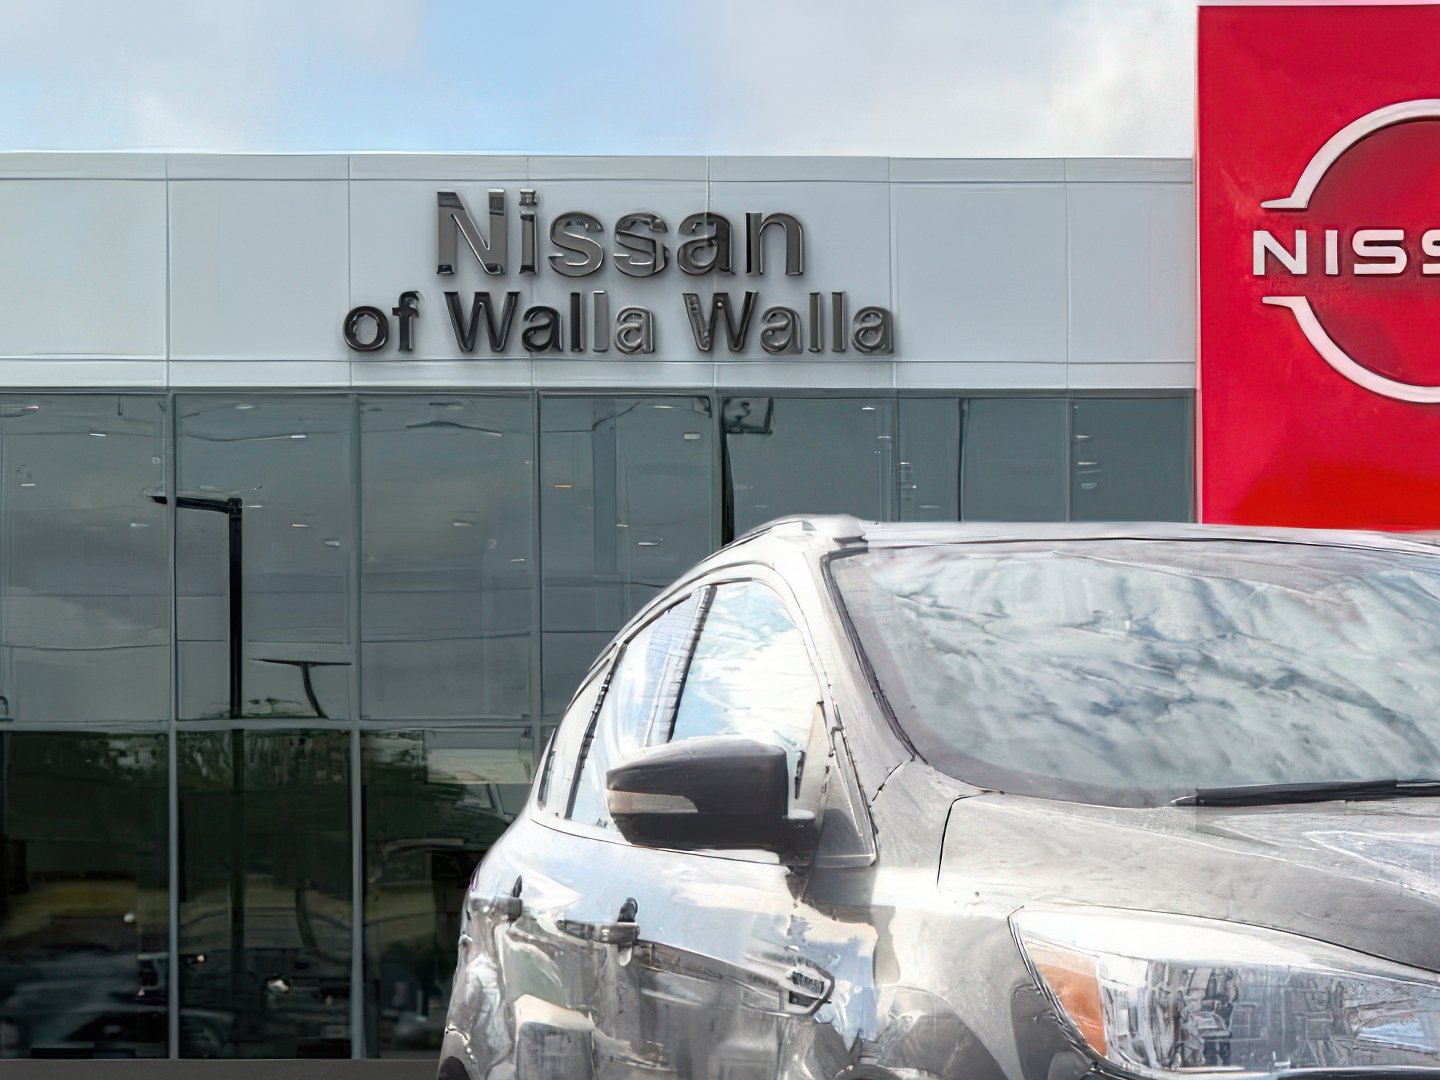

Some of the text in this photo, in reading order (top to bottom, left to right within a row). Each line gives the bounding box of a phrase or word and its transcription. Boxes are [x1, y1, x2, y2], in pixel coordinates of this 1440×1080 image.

[436, 187, 804, 278] Nissan
[342, 290, 895, 355] of Walla Walla
